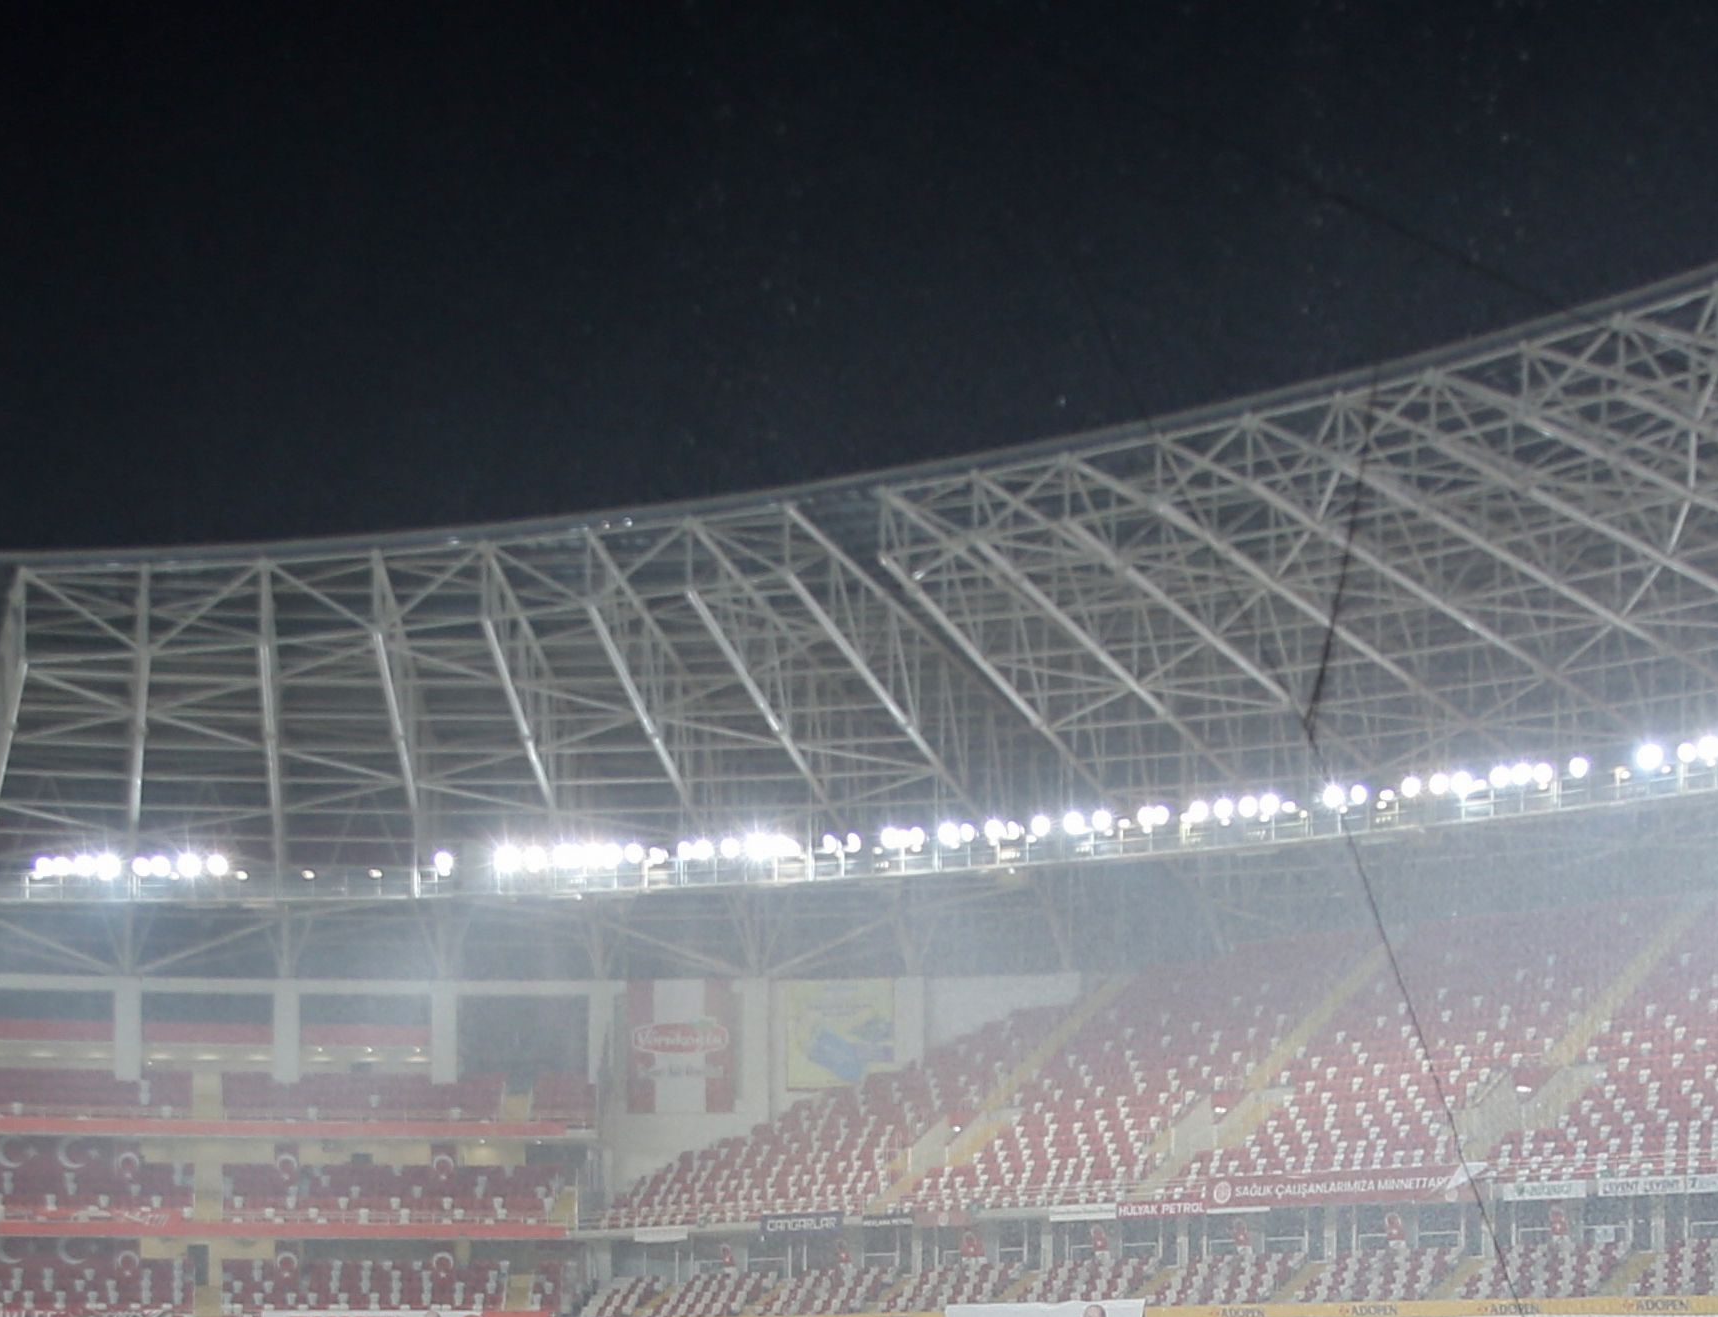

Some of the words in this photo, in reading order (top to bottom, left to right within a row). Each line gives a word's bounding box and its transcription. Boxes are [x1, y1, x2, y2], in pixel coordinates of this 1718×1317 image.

[1235, 1182, 1273, 1198] SAĞLIK
[1161, 1201, 1205, 1215] PETROL
[1636, 1299, 1688, 1312] ADOPEN
